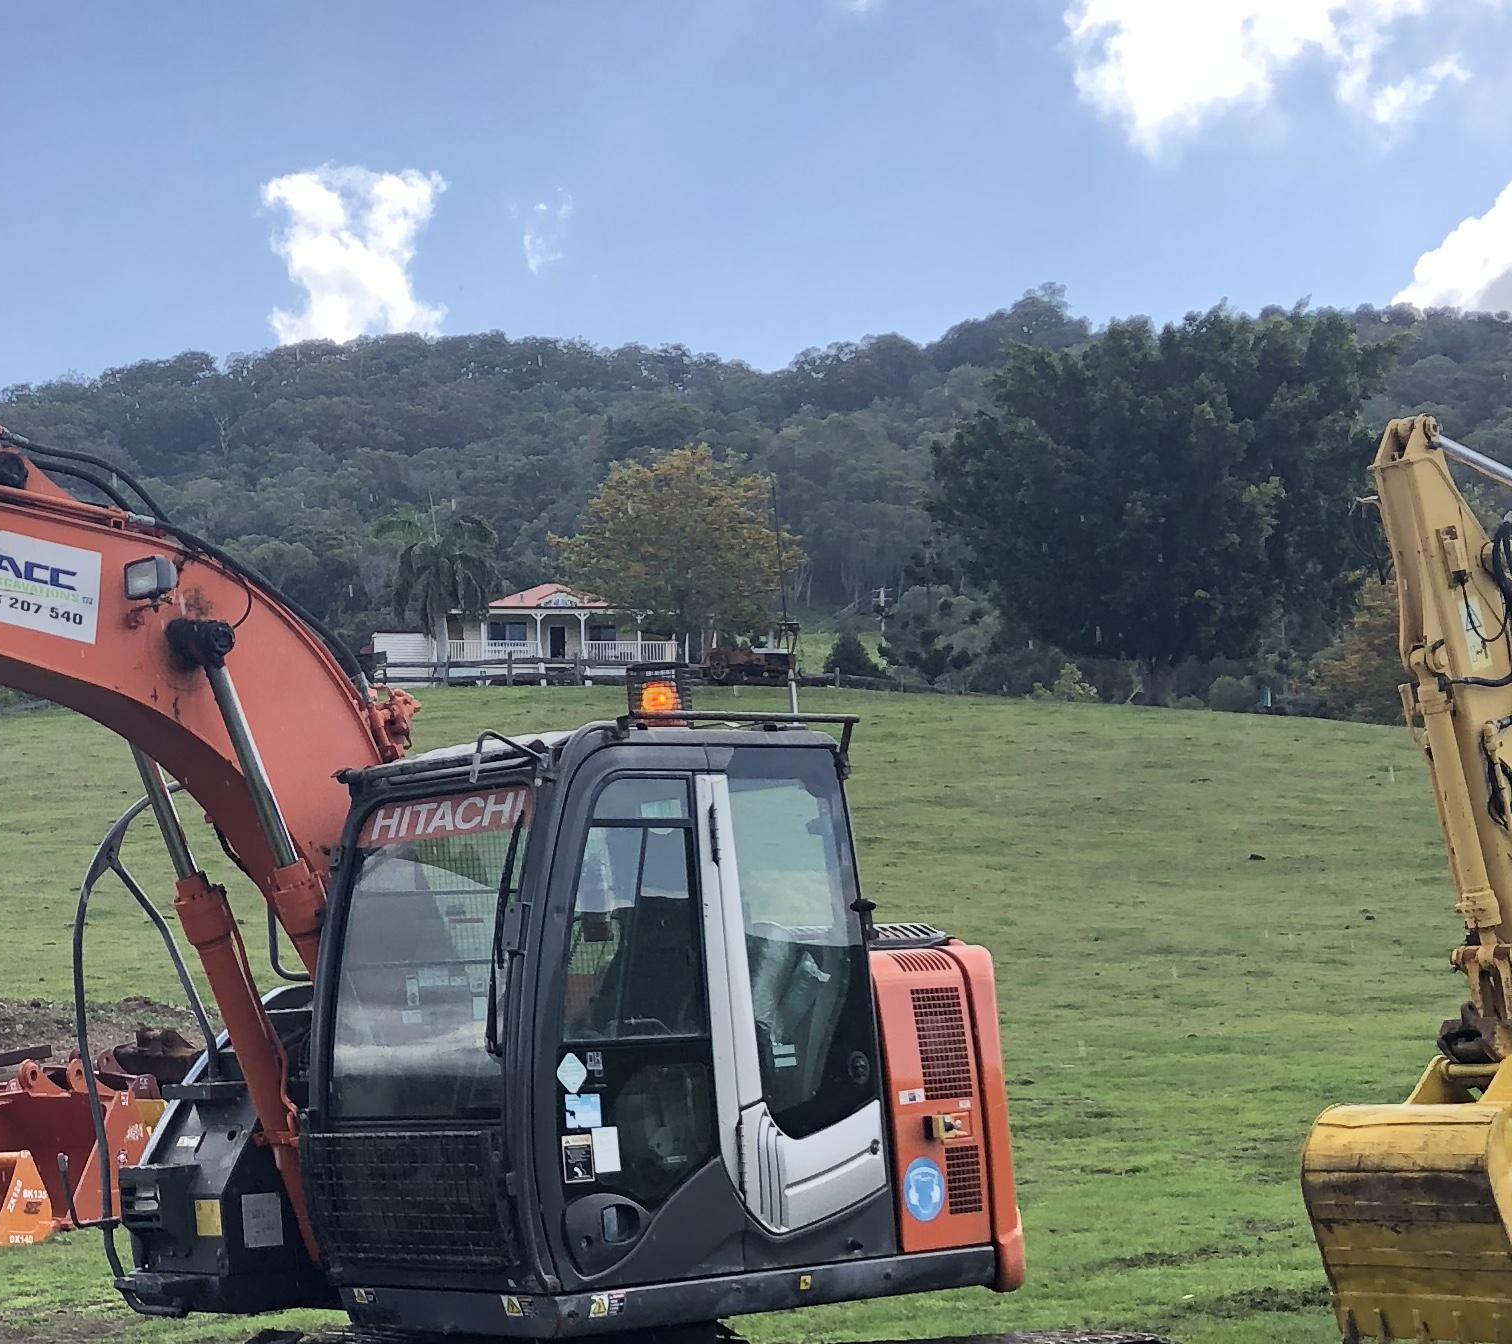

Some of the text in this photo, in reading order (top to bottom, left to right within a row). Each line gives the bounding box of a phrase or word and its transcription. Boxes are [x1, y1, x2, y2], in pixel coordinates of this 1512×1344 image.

[9, 597, 42, 614] 207
[49, 607, 83, 625] 540
[371, 790, 526, 840] HITACHI
